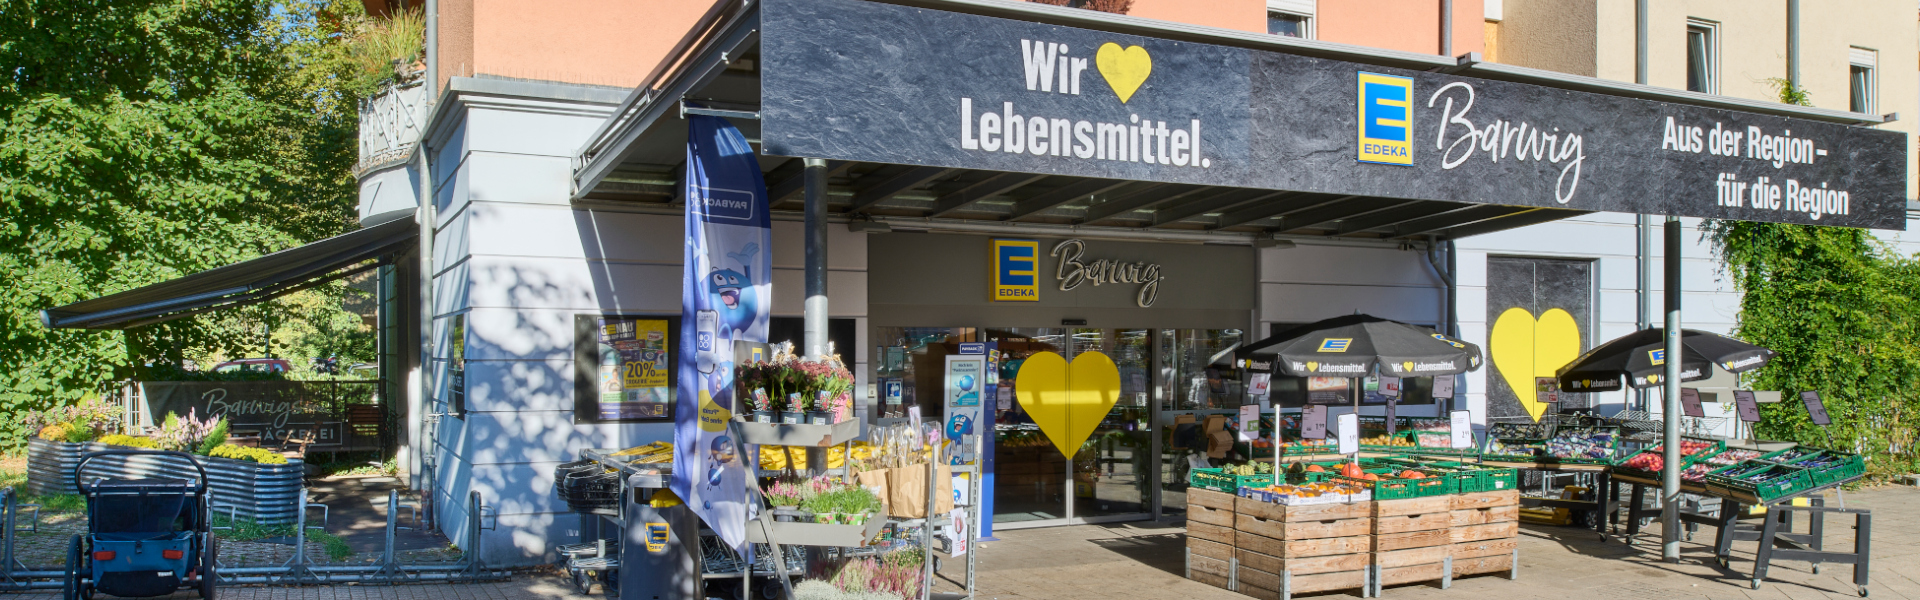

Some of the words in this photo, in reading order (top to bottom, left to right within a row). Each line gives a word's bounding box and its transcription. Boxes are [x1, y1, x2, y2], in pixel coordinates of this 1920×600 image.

[1021, 39, 1087, 95] Wir
[961, 97, 1210, 168] Lebensmittel.
[1428, 82, 1586, 204] Barwig
[1662, 116, 1703, 153] Aus
[1709, 122, 1742, 157] der
[1748, 125, 1813, 168] Region
[1364, 143, 1407, 157] EDEKA
[1717, 173, 1746, 207] für
[1751, 176, 1780, 210] die
[1786, 179, 1849, 220] Region
[1051, 239, 1164, 307] Barwig
[999, 288, 1035, 297] EDEKA
[601, 322, 633, 336] GENAU
[626, 362, 656, 378] 20%
[1293, 362, 1306, 371] Wir
[1319, 363, 1367, 373] Lebensmittel.
[1414, 361, 1457, 372] Lebensmittel.
